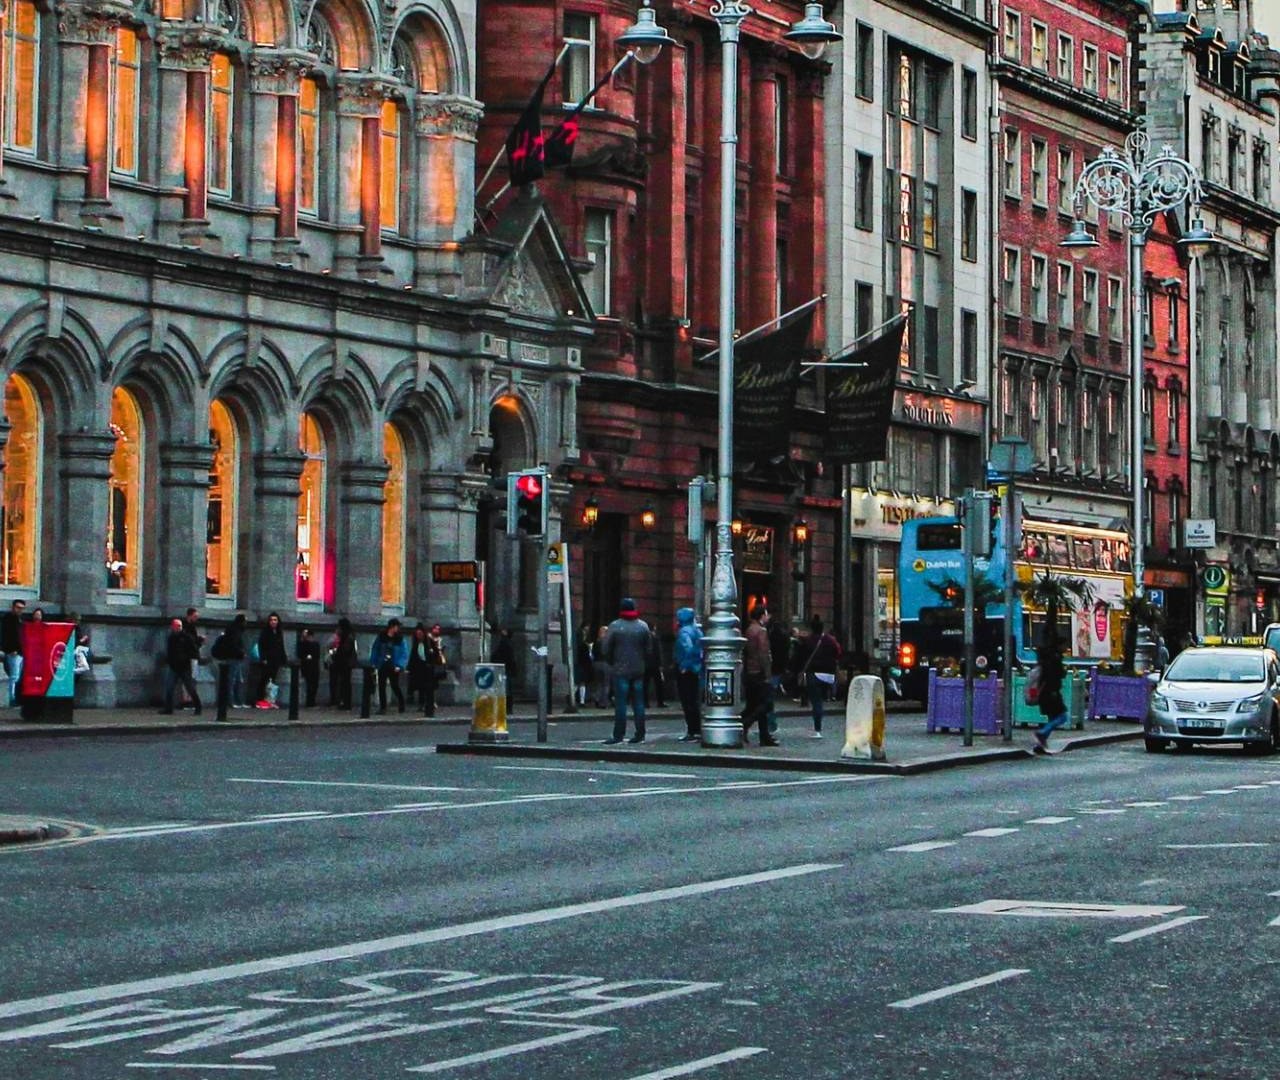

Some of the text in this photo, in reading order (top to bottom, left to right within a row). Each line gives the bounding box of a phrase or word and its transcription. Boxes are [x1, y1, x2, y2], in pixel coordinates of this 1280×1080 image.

[903, 404, 954, 425] SOLUTIONS
[926, 560, 947, 569] Dublin
[1222, 636, 1242, 644] TAXI
[250, 968, 724, 1020] BUS
